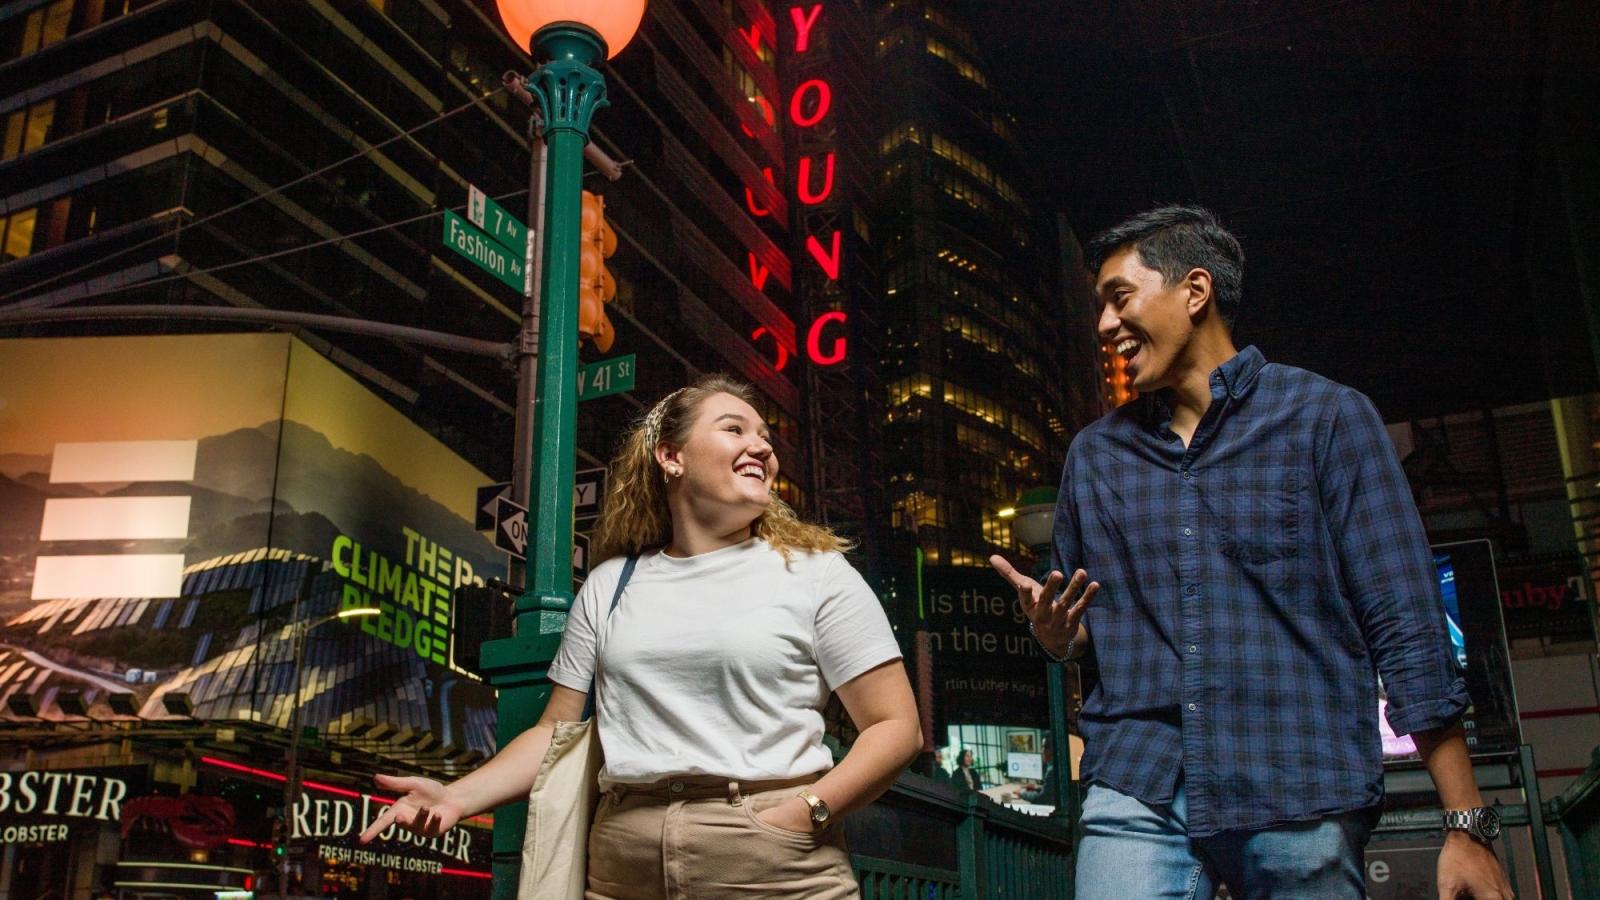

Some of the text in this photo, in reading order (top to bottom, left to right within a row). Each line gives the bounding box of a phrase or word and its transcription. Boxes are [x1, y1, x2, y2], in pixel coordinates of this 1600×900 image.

[495, 209, 518, 239] 7 Av
[450, 217, 522, 277] Fashion Av
[592, 364, 611, 392] 41
[617, 361, 630, 379] St
[402, 526, 453, 586] THE
[332, 534, 450, 626] CLIMATE
[929, 588, 954, 614] is
[960, 588, 1005, 616] the
[341, 583, 448, 667] PLEDGE
[951, 624, 998, 653] the
[291, 792, 354, 839] RED
[318, 844, 443, 875] FRESH FISH LIVE LOBSTER
